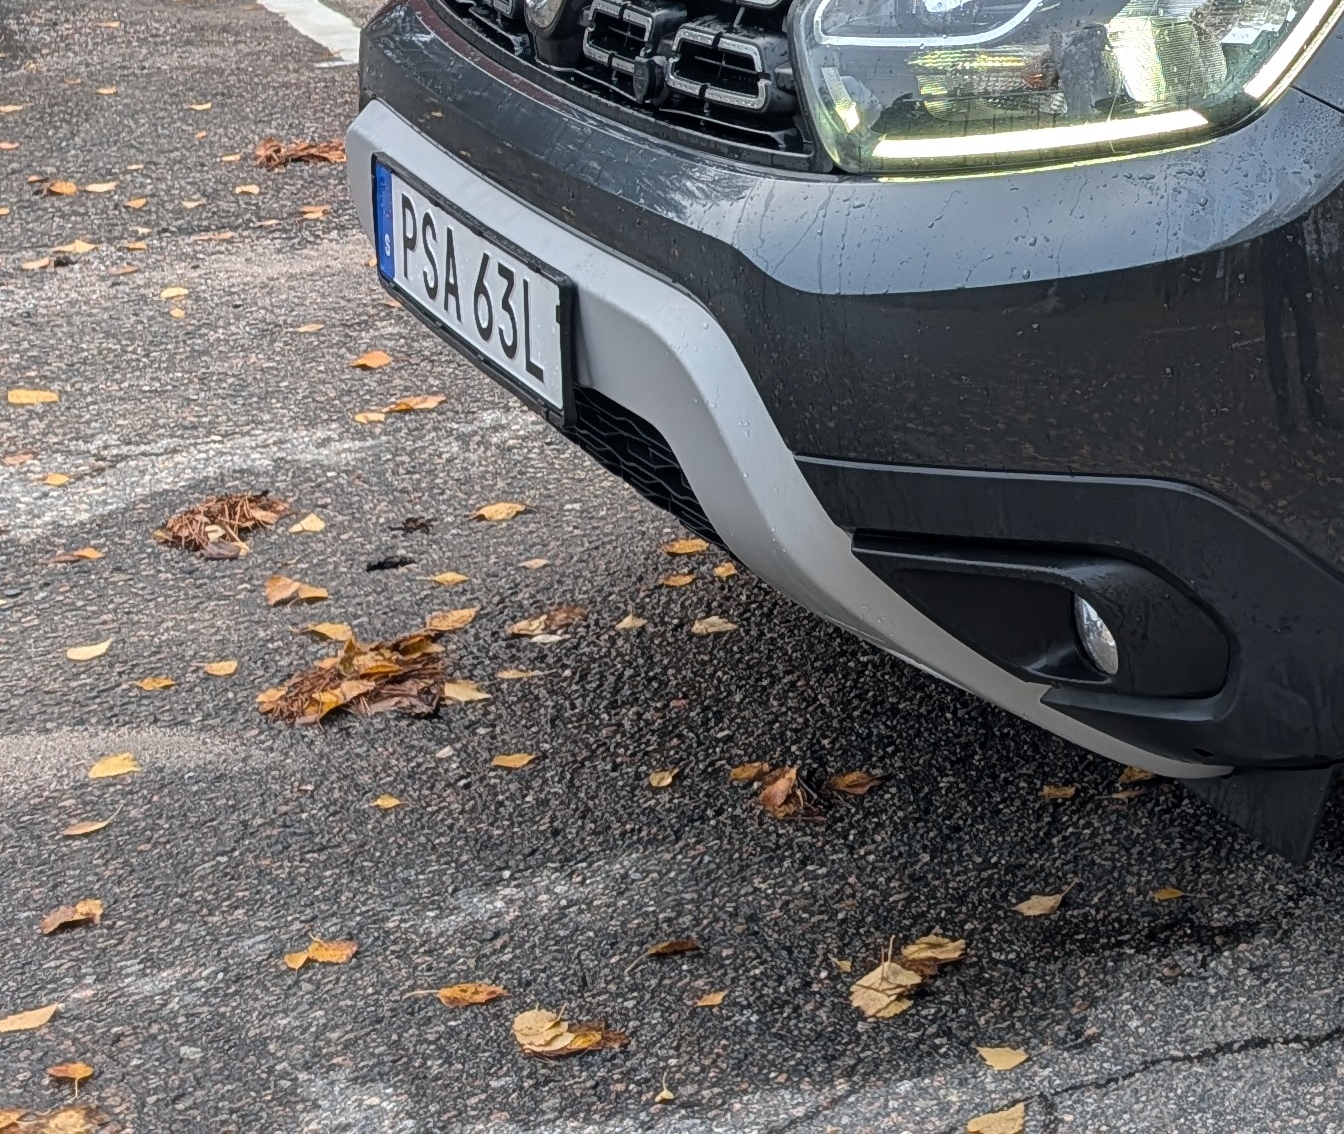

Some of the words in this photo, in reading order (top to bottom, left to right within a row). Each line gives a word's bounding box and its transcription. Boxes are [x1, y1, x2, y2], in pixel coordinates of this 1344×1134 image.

[383, 232, 391, 257] S
[400, 192, 463, 324] PSA
[473, 252, 545, 384] 63L
